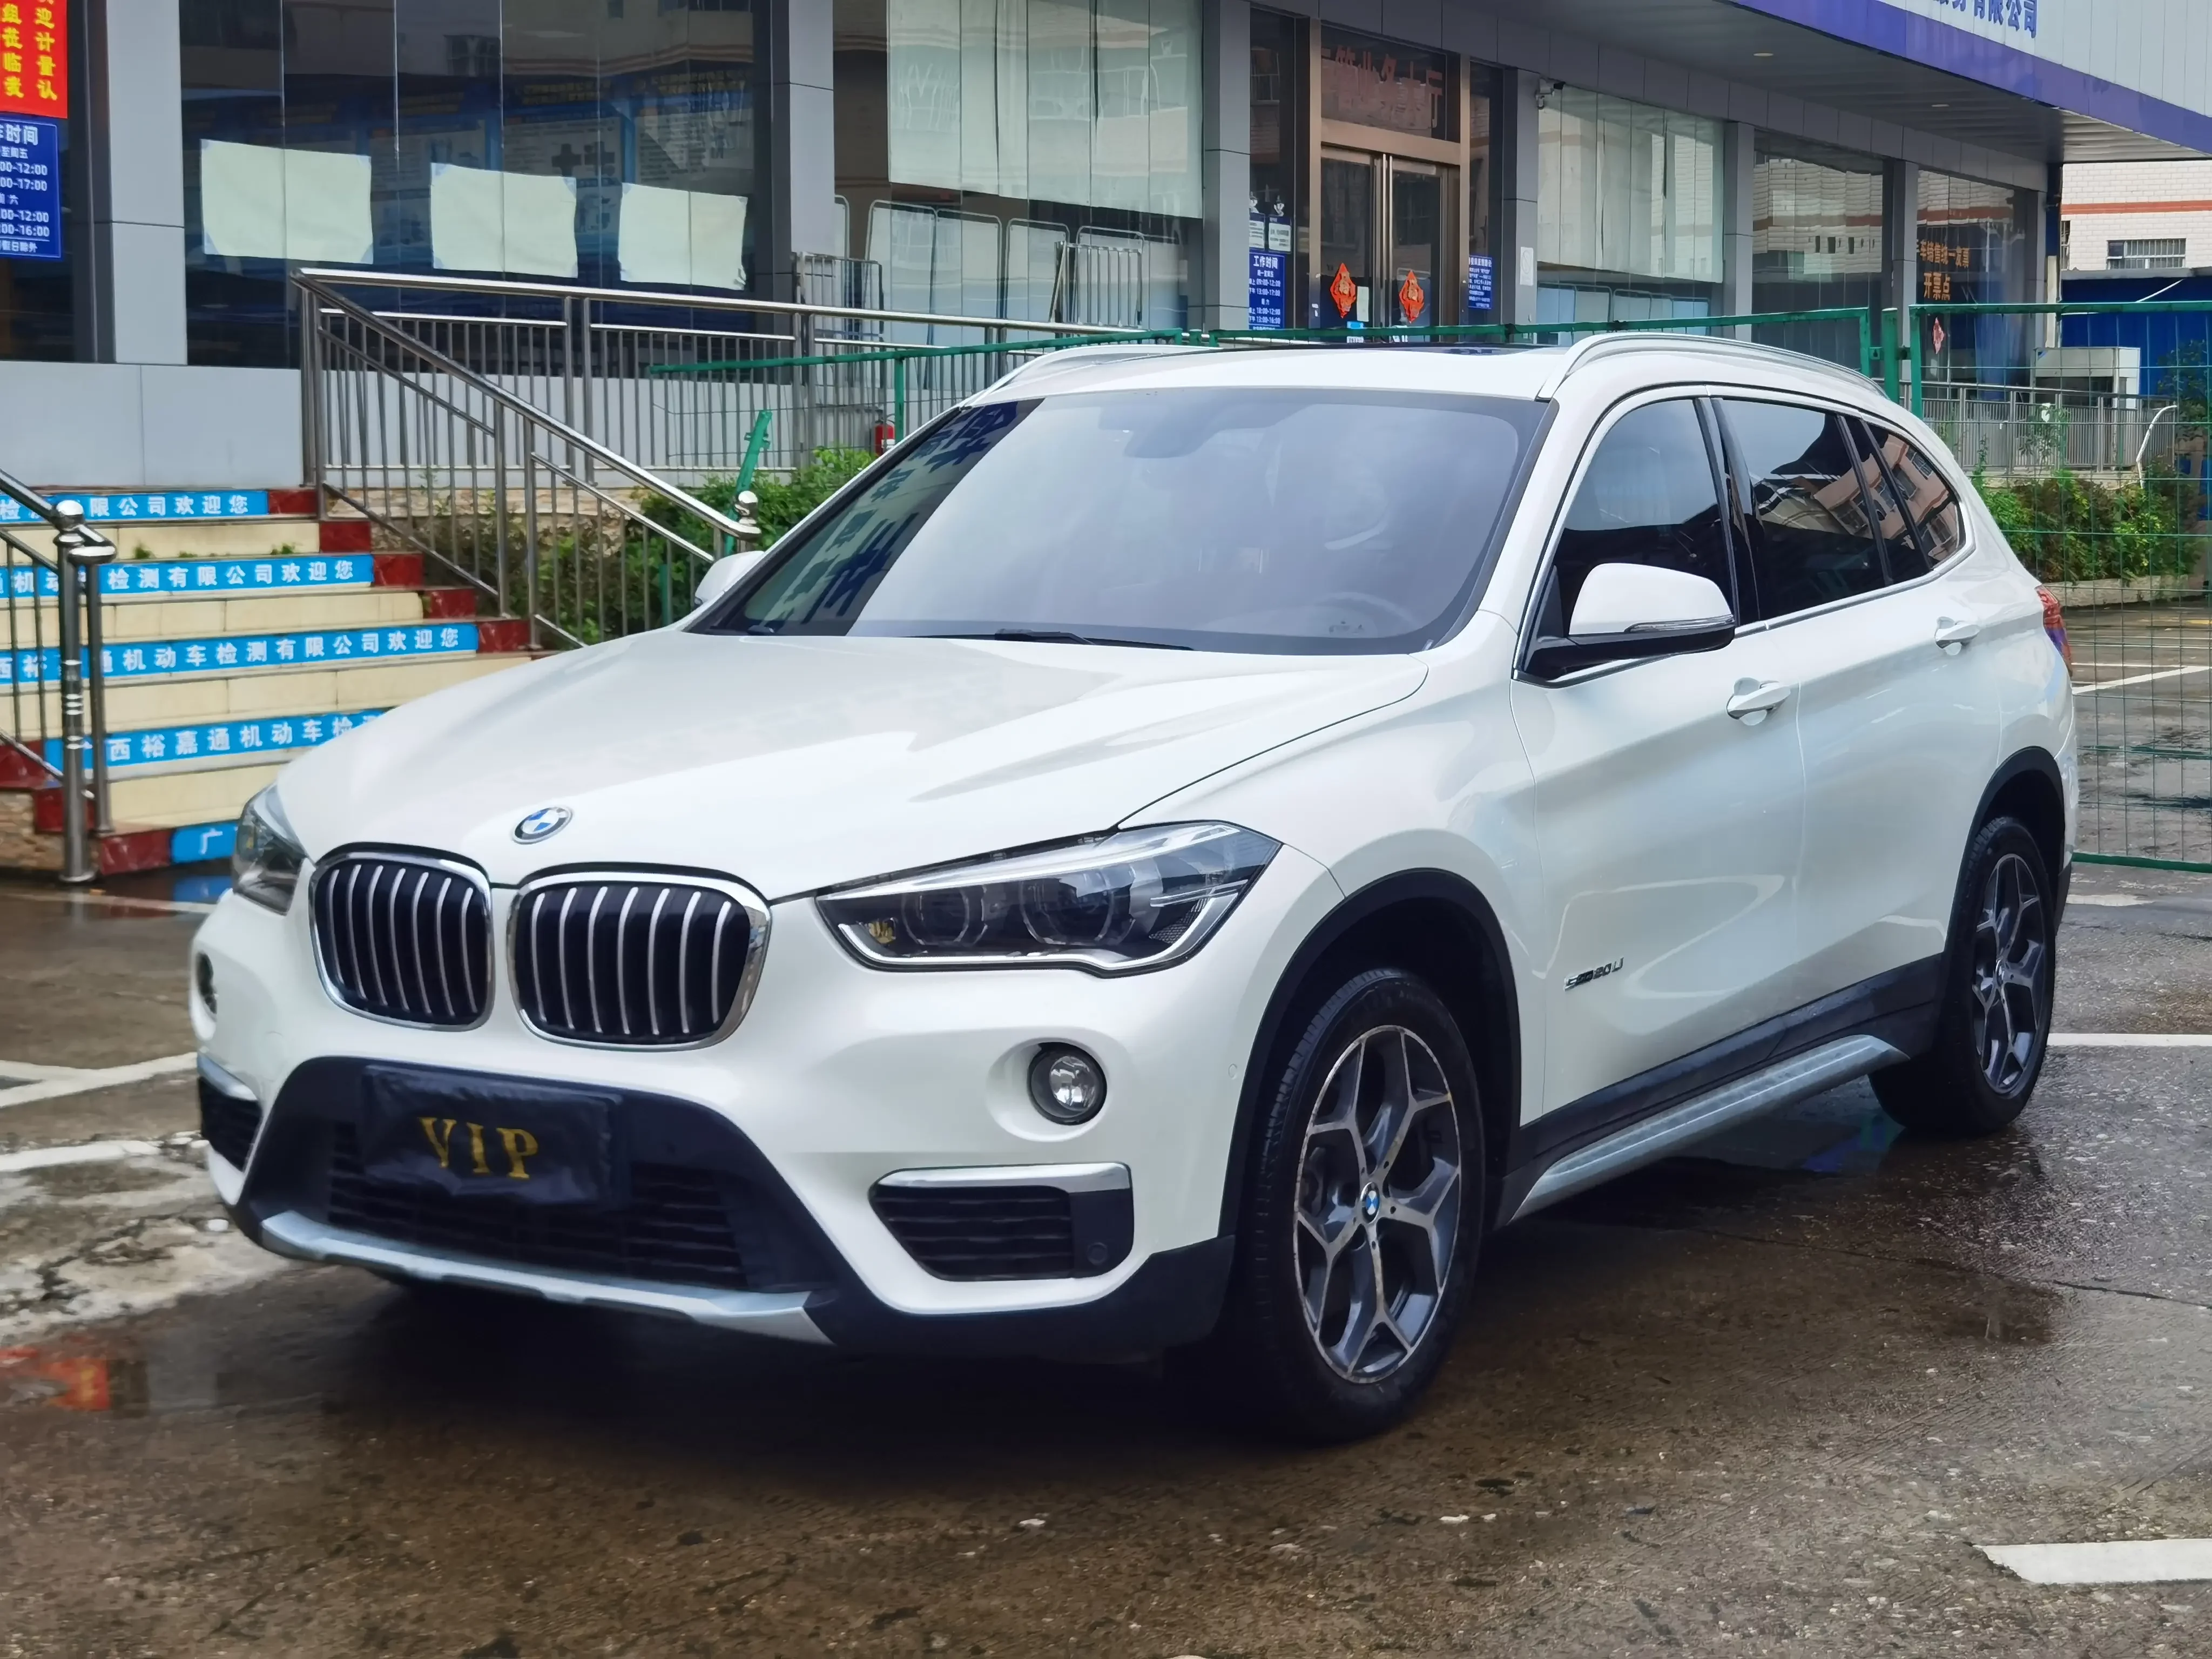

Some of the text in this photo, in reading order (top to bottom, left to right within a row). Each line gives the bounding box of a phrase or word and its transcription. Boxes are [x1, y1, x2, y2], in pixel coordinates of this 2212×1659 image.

[35, 0, 57, 100] 迎计量认
[1253, 255, 1278, 269] 工作时间
[1917, 239, 1970, 268] 车销售统一发票
[1924, 272, 1950, 301] 开票点
[0, 494, 248, 522] 检限公司欢迎您
[0, 560, 354, 593] 机动检测有限公司欢迎您
[82, 714, 377, 761] 西裕嘉通机动车检
[418, 1117, 538, 1179] VIP
